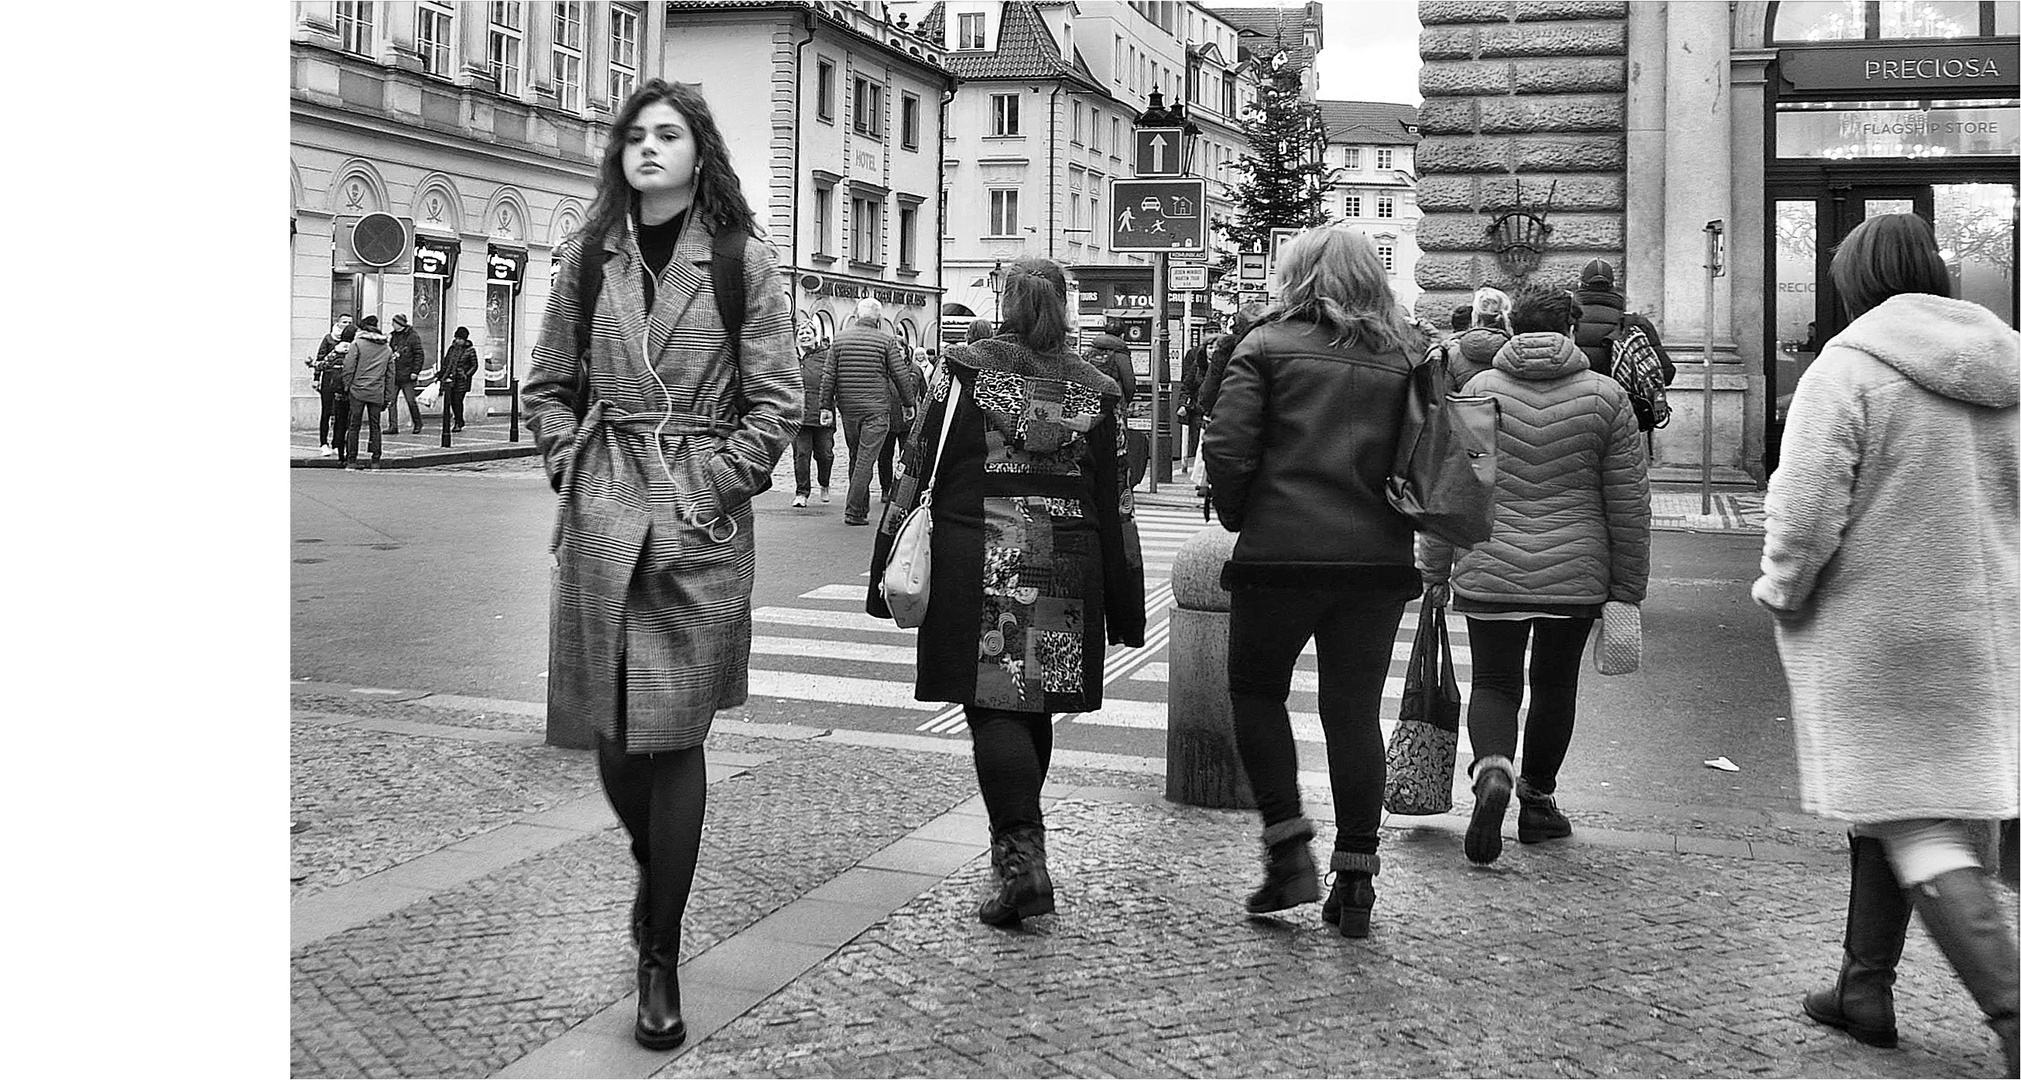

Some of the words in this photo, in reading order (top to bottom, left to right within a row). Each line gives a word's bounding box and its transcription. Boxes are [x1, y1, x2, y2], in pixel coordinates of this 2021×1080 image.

[1865, 57, 2001, 79] PRECIOSA
[1863, 123, 1940, 135] FLAGSHIP
[1945, 122, 1998, 134] STORE
[855, 149, 877, 172] HOTEL
